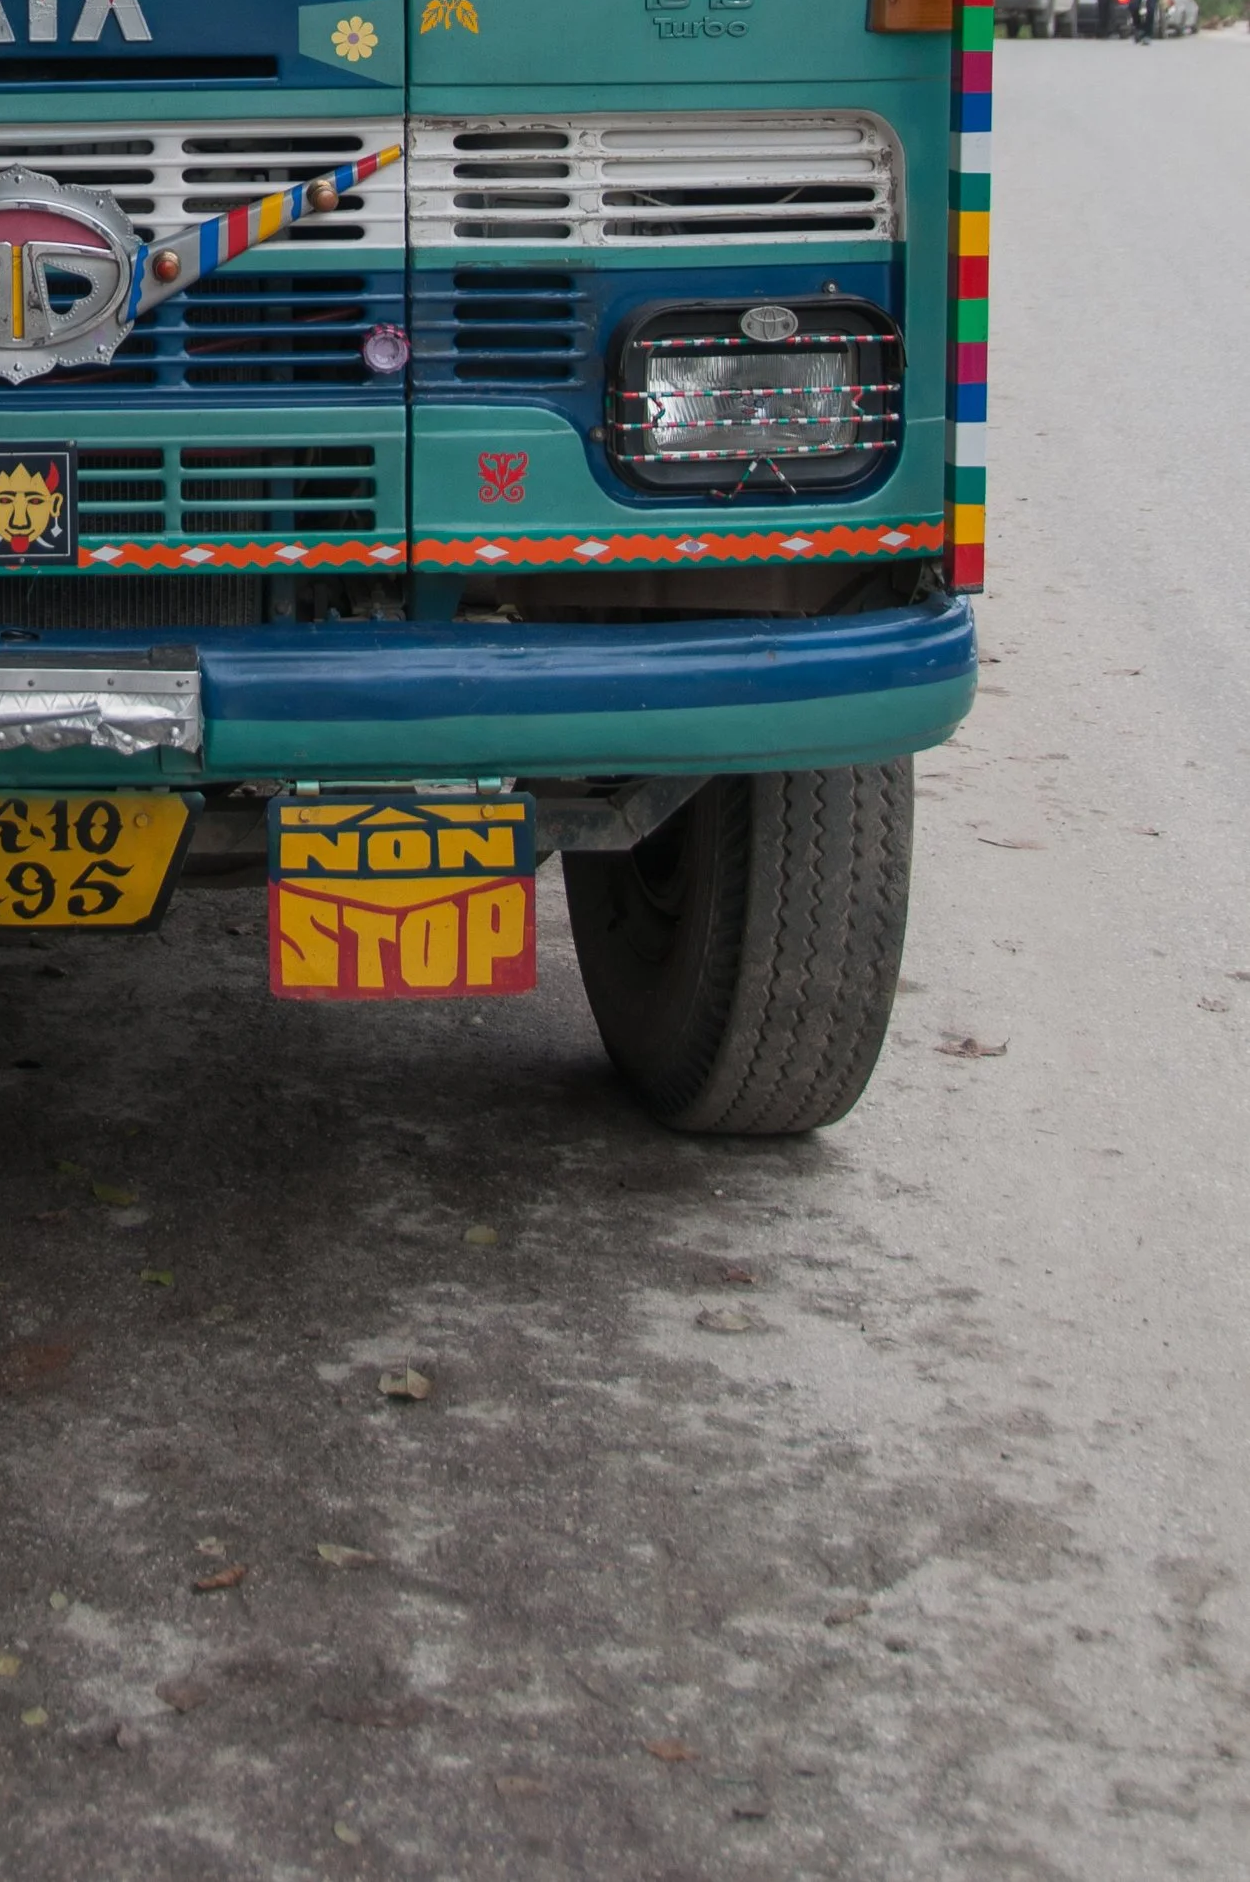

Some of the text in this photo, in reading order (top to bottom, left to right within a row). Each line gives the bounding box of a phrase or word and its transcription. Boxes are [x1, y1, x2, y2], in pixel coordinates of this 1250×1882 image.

[653, 16, 750, 39] Turbo
[280, 826, 515, 872] NON
[278, 882, 526, 988] STOP
